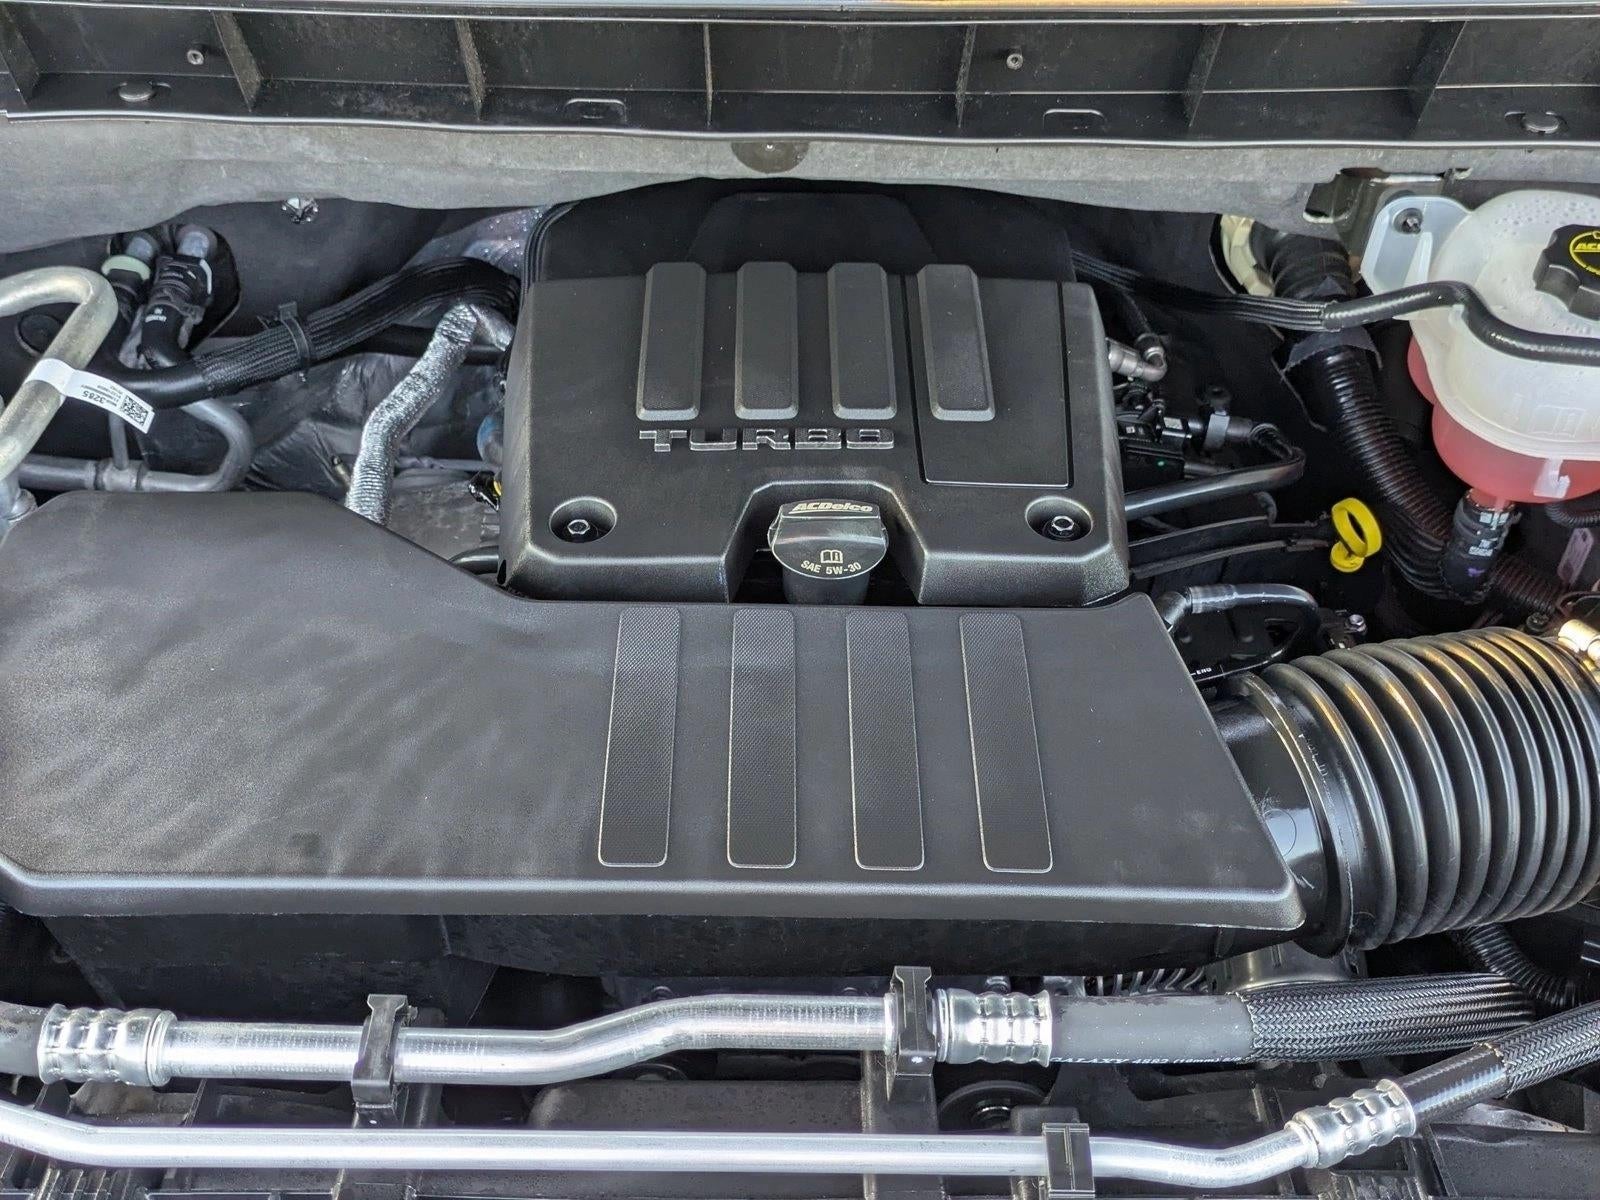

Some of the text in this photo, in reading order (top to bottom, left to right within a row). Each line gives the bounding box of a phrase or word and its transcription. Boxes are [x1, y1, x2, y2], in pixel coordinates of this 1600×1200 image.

[82, 390, 106, 404] 3285
[638, 428, 895, 452] TURBO
[789, 502, 873, 514] ACDelco
[801, 560, 862, 575] SAE 5W-30
